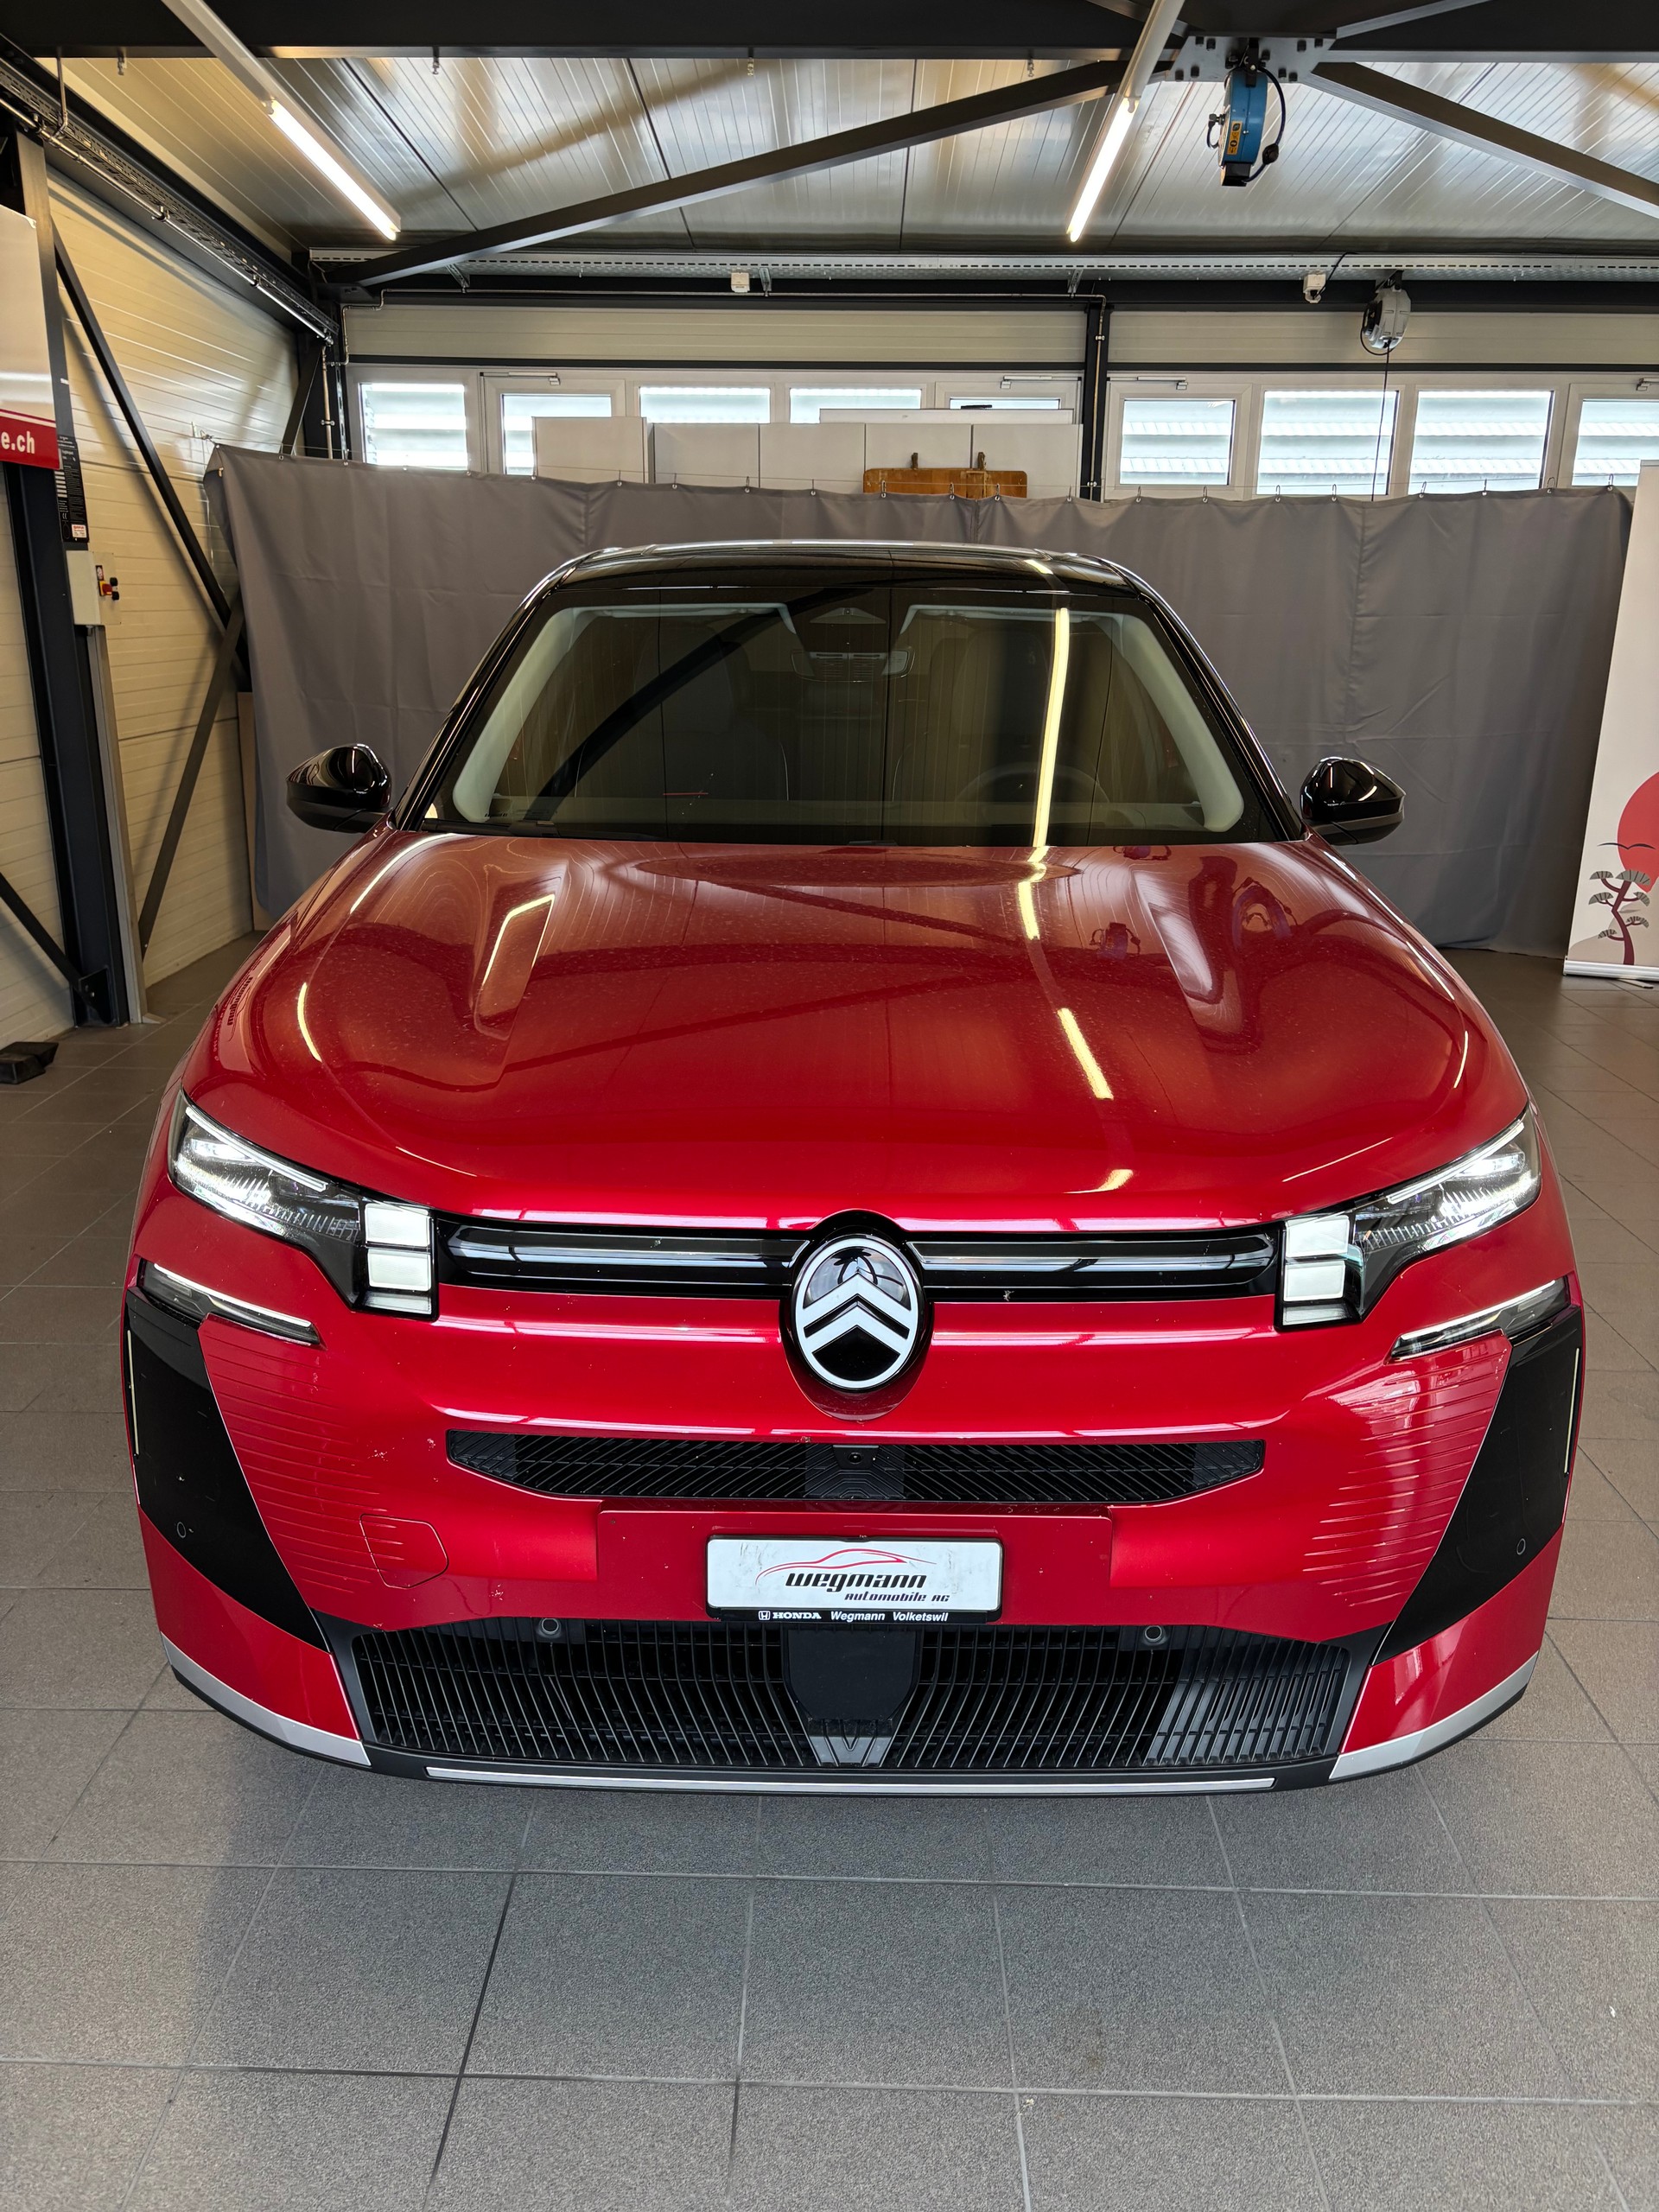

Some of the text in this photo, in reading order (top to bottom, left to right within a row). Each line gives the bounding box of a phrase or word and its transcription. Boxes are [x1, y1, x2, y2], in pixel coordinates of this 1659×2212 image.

[1, 430, 35, 454] e.ch
[785, 1573, 927, 1592] wegmann
[844, 1591, 927, 1602] automobile
[830, 1611, 886, 1623] Wegmann
[893, 1611, 949, 1622] Volketswil
